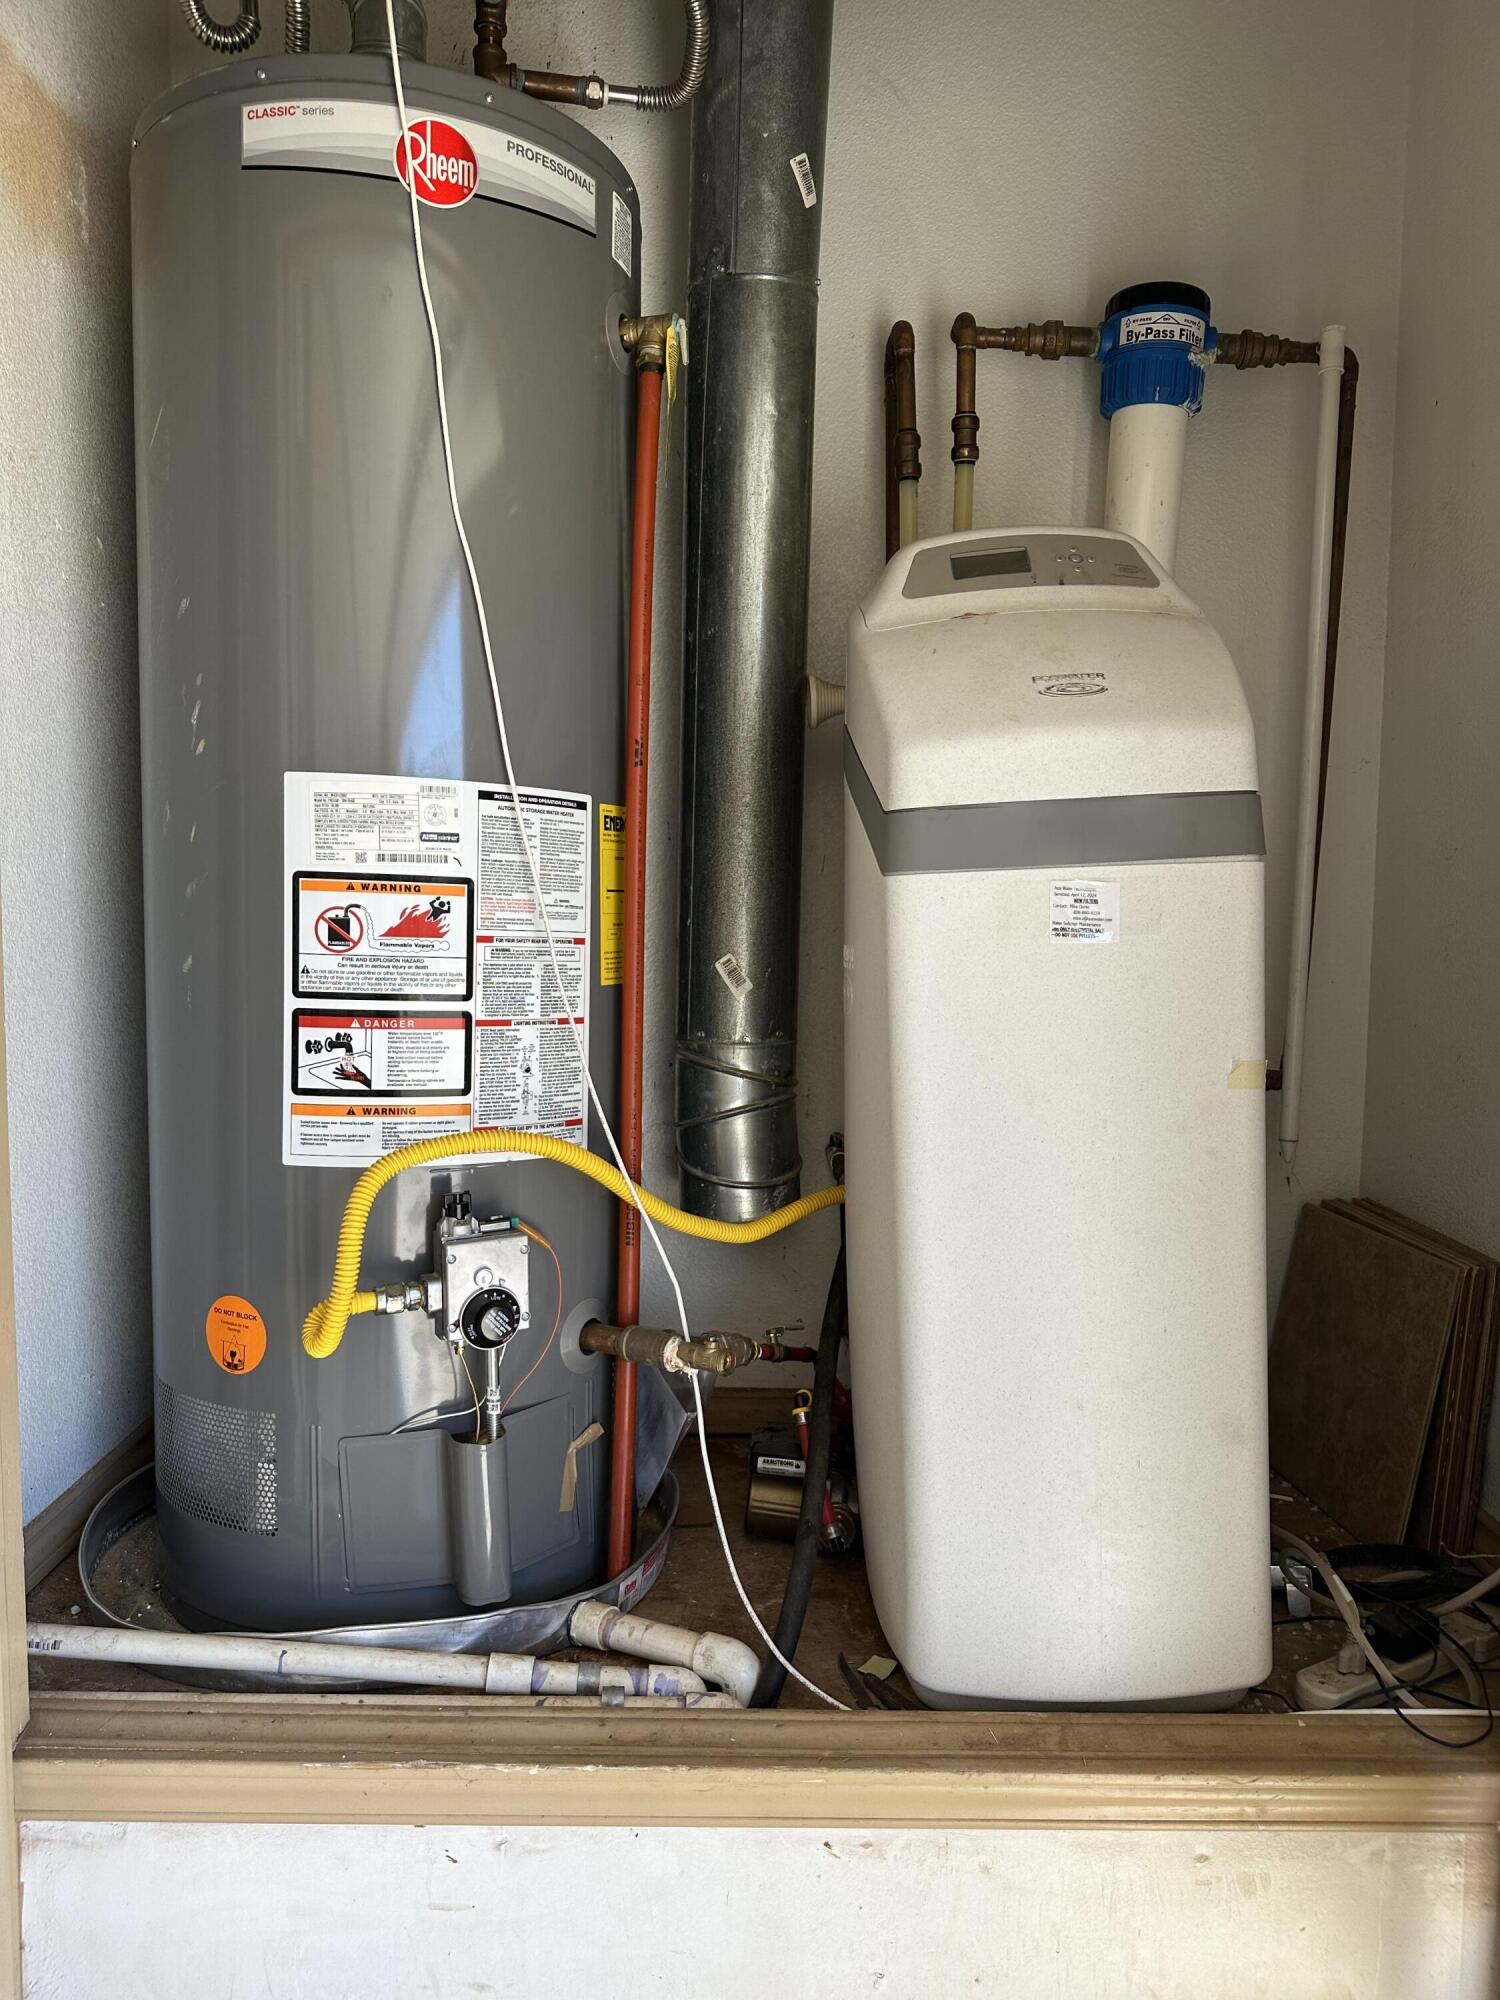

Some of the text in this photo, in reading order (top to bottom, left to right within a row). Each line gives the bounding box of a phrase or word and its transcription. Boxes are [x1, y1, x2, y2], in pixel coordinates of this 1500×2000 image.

[302, 106, 334, 116] series
[405, 120, 474, 191] Rheem
[506, 140, 594, 195] PROFESSIONAL
[1126, 327, 1202, 346] By-Pass Filter
[361, 882, 422, 893] WARNING
[364, 1020, 415, 1028] DANGER
[362, 1107, 416, 1115] WARNING
[236, 1312, 257, 1321] BLOCK
[762, 1458, 794, 1466] ARMSTRONG
